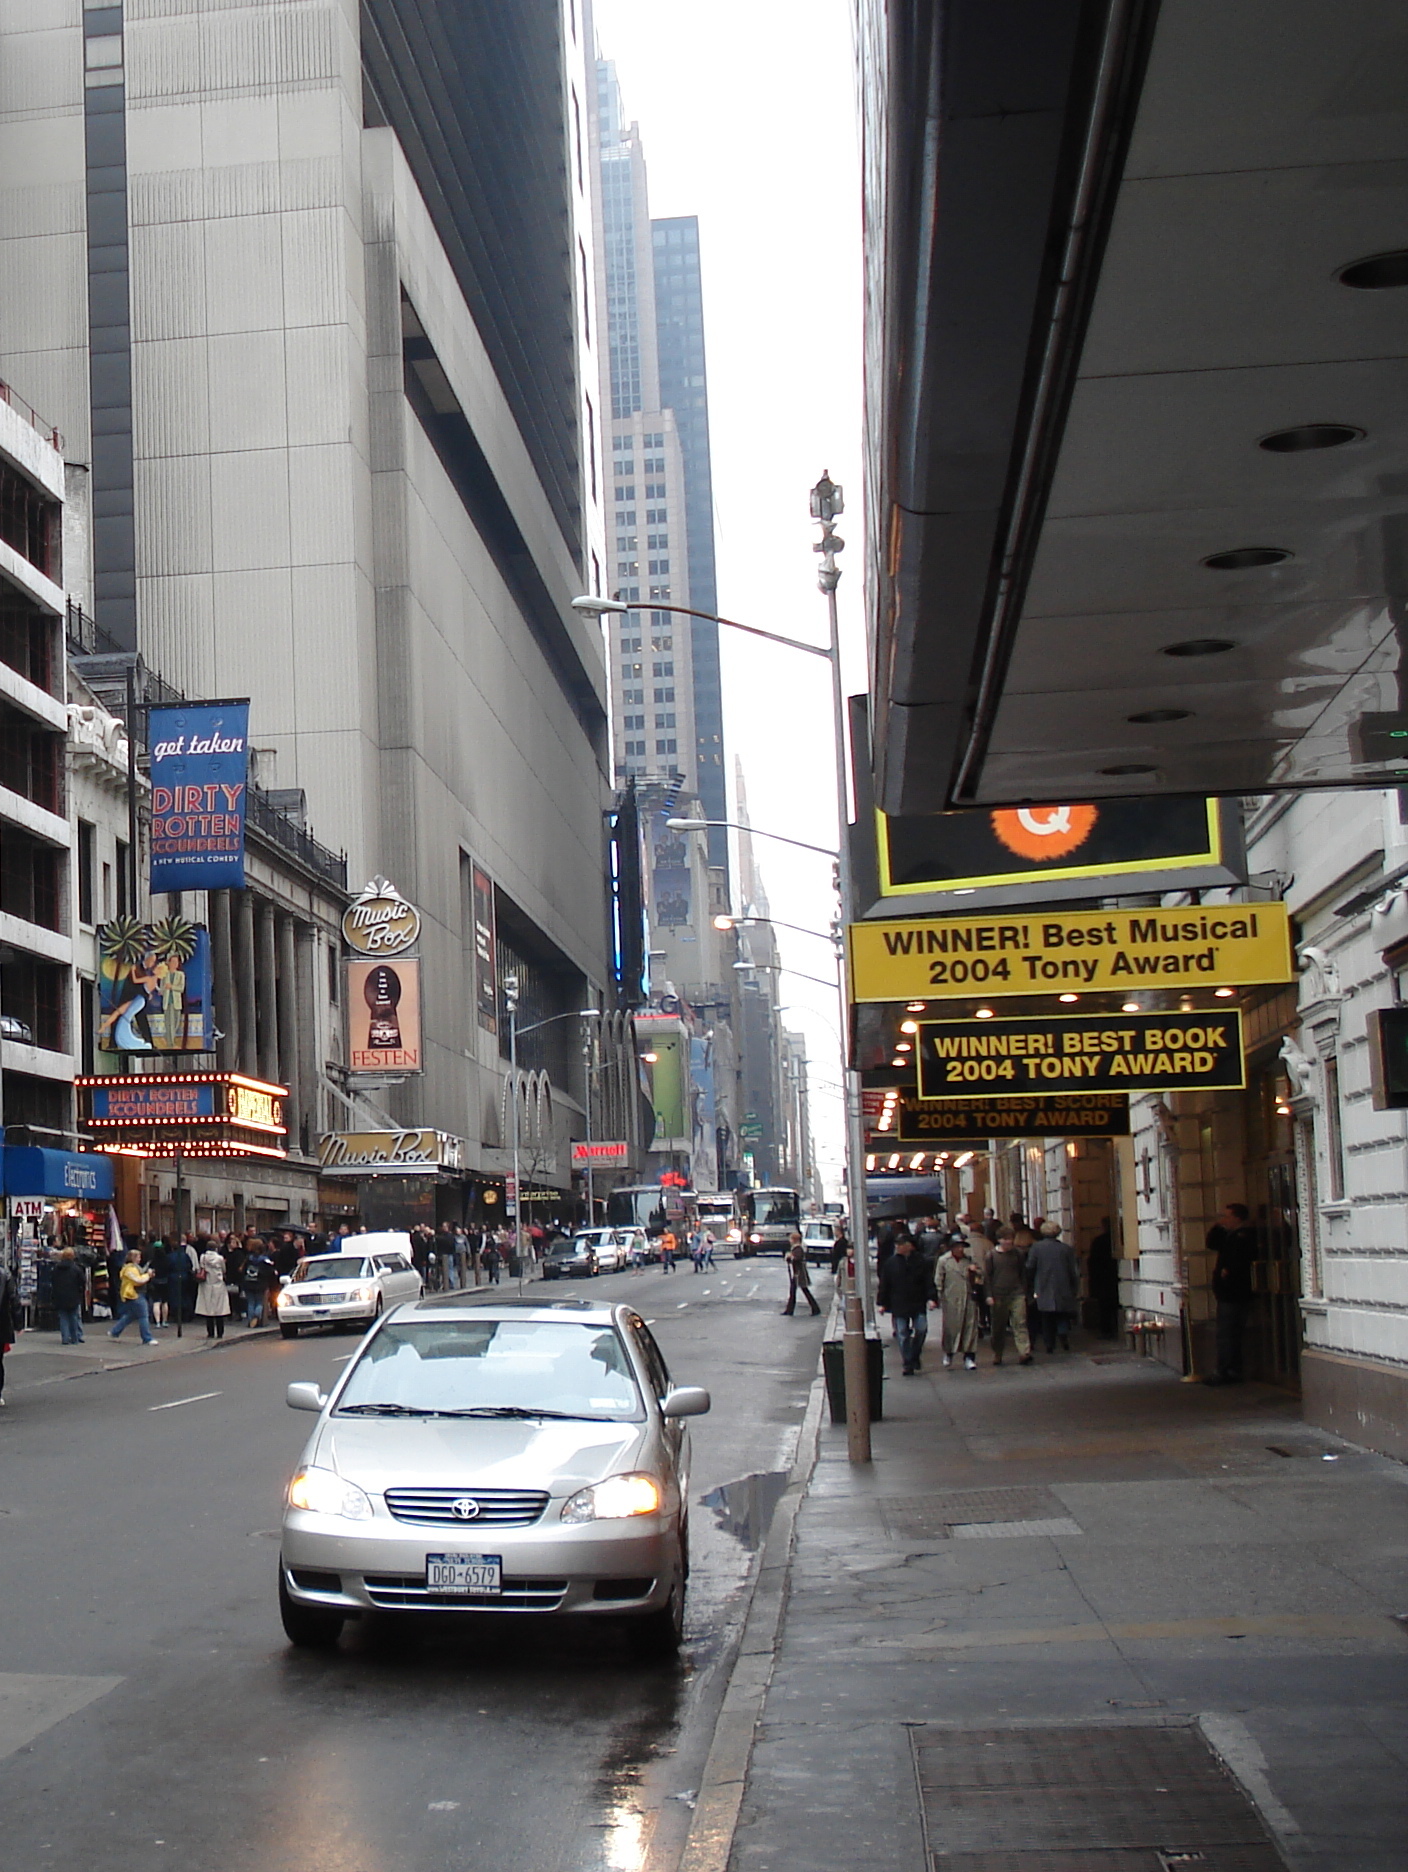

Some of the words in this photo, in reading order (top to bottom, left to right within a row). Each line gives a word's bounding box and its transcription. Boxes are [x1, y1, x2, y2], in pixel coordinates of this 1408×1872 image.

[154, 736, 185, 763] get
[186, 732, 243, 755] taken
[152, 783, 244, 815] DIRTY
[152, 813, 240, 839] ROTTEN
[152, 836, 240, 855] SCOUNDRELS
[175, 855, 205, 865] MUSICAL
[207, 854, 240, 864] COMEDY
[352, 901, 408, 929] Music
[362, 923, 414, 950] Box
[883, 925, 1030, 956] WINNER!
[1043, 920, 1117, 949] Best
[1129, 913, 1258, 943] Musical
[929, 957, 1011, 985] 2004
[1022, 954, 1098, 983] Tony
[934, 1033, 1055, 1059] WINNER!
[1062, 1030, 1137, 1054] BEST
[1144, 1026, 1228, 1051] BOOK
[352, 1049, 418, 1068] FESTEN
[945, 1059, 1016, 1082] 2004
[1022, 1056, 1102, 1080] TONY
[1108, 1051, 1215, 1076] AWARD
[108, 1088, 147, 1103] DIRTY
[148, 1088, 198, 1102] ROTTEN
[108, 1100, 198, 1117] SCOUNDRELS
[996, 1097, 1047, 1110] BEST
[1053, 1094, 1125, 1109] SCORE
[917, 1113, 968, 1129] 2004
[974, 1112, 1027, 1128] TONY
[1033, 1110, 1110, 1127] AWARD
[319, 1131, 388, 1166] Music
[389, 1131, 433, 1164] Box
[15, 1202, 42, 1215] ATM
